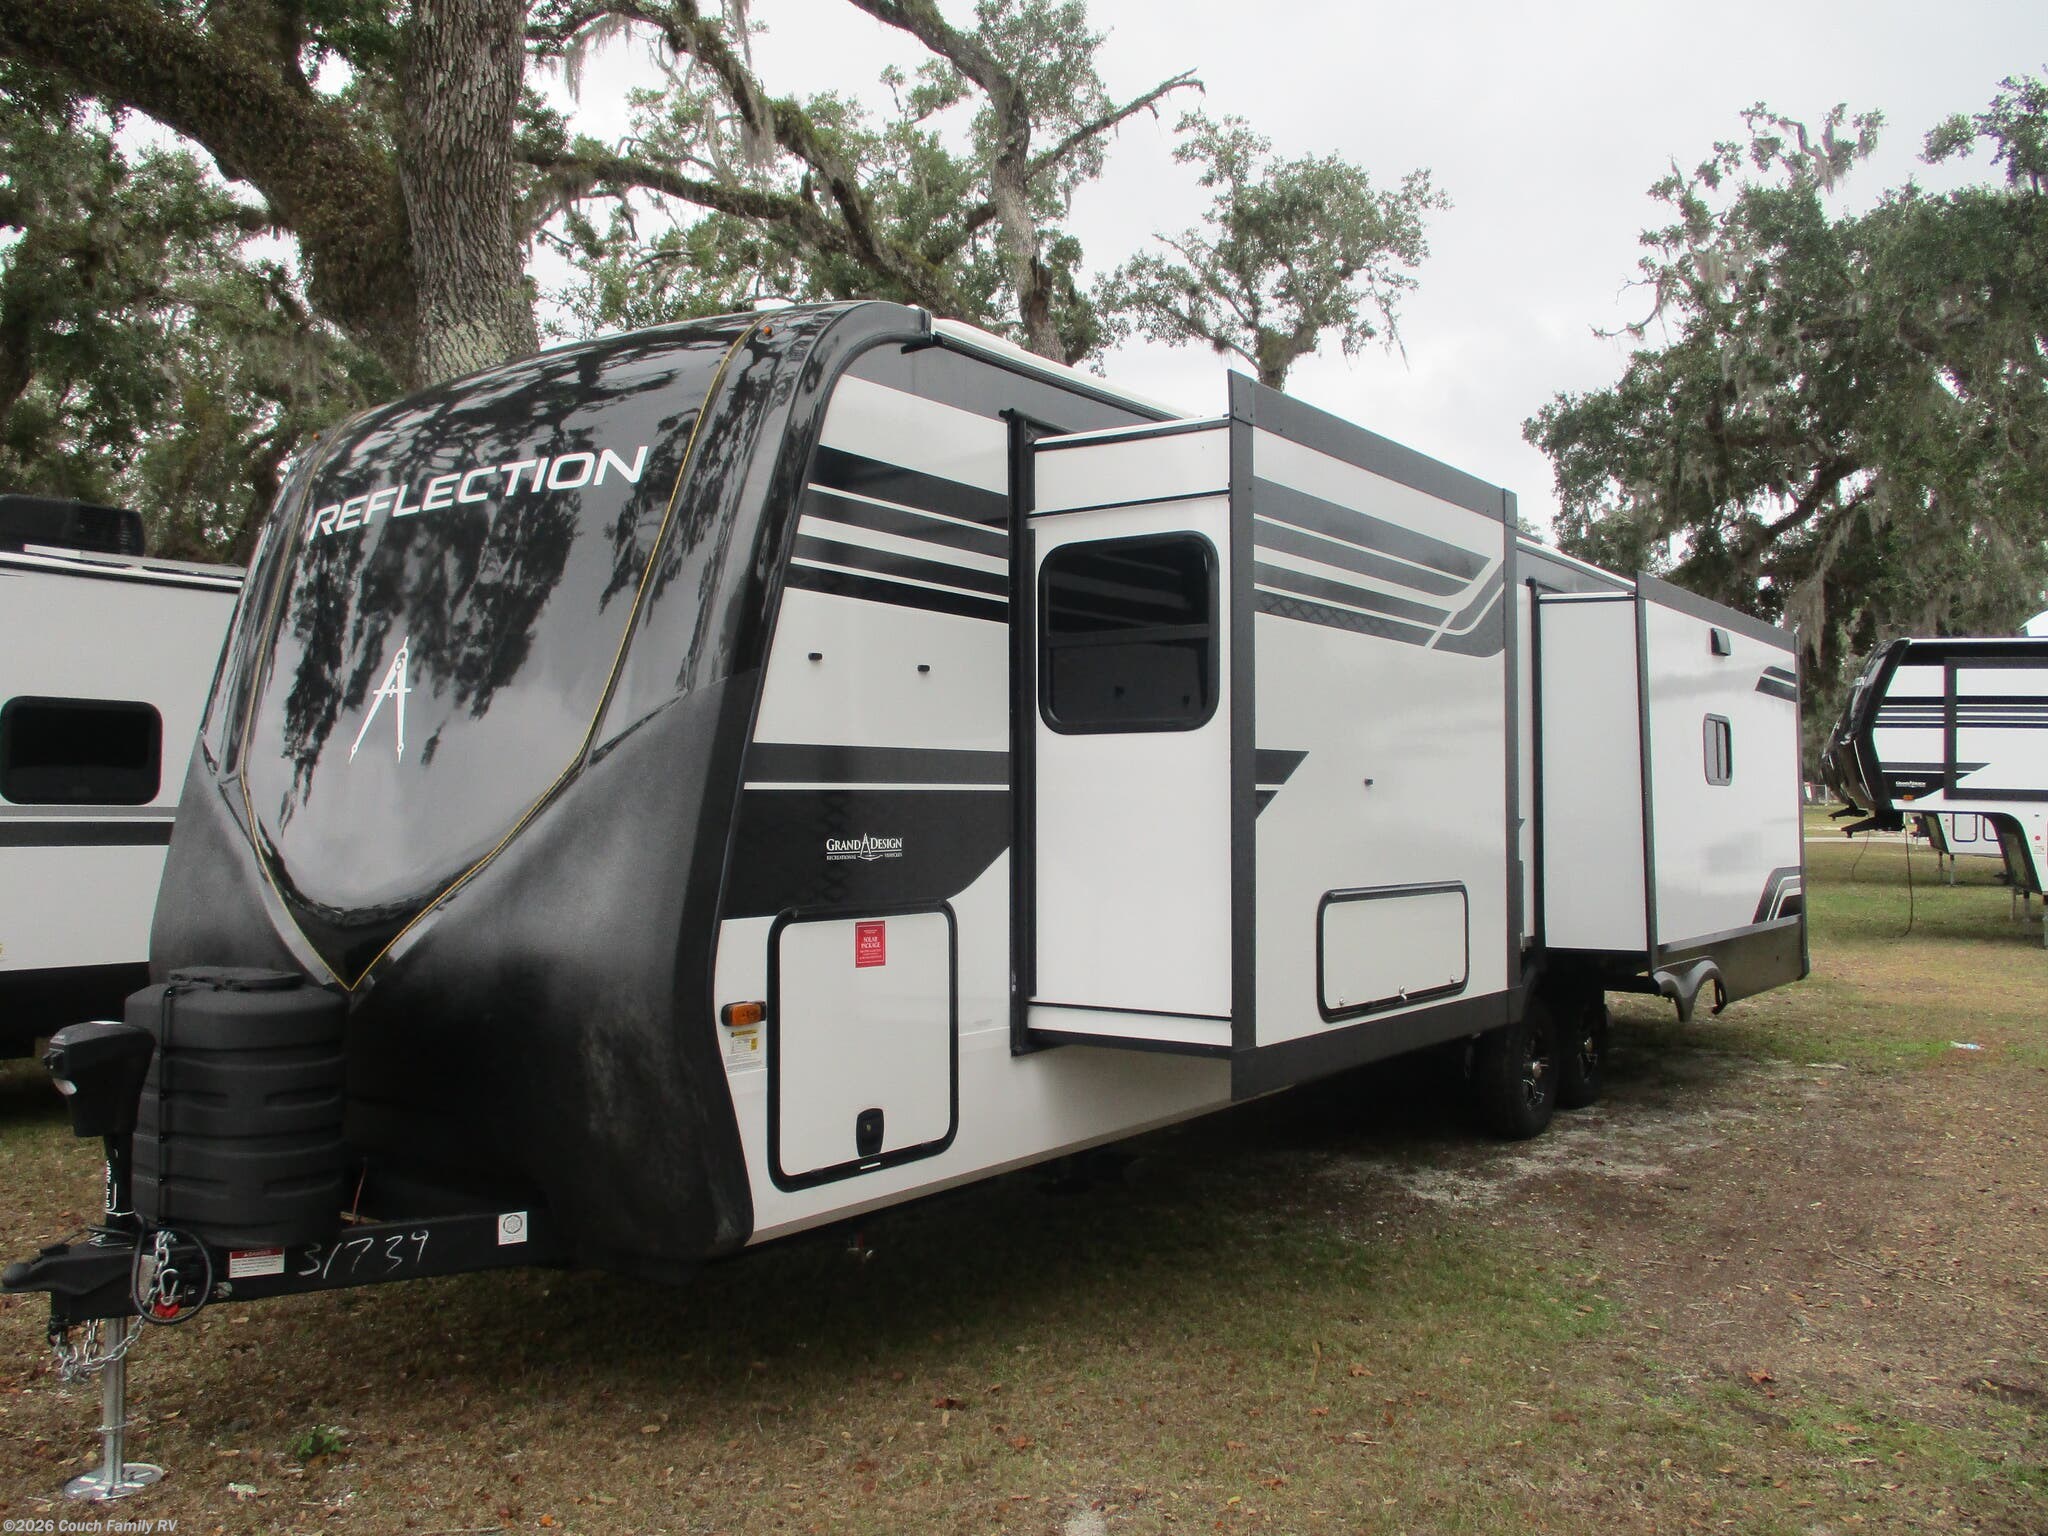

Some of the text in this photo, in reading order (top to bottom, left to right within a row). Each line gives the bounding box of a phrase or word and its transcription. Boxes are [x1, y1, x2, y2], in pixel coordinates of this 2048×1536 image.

[308, 446, 649, 541] REFLECTION
[826, 837, 903, 851] GRAND DESIGN
[298, 1230, 429, 1279] 31739
